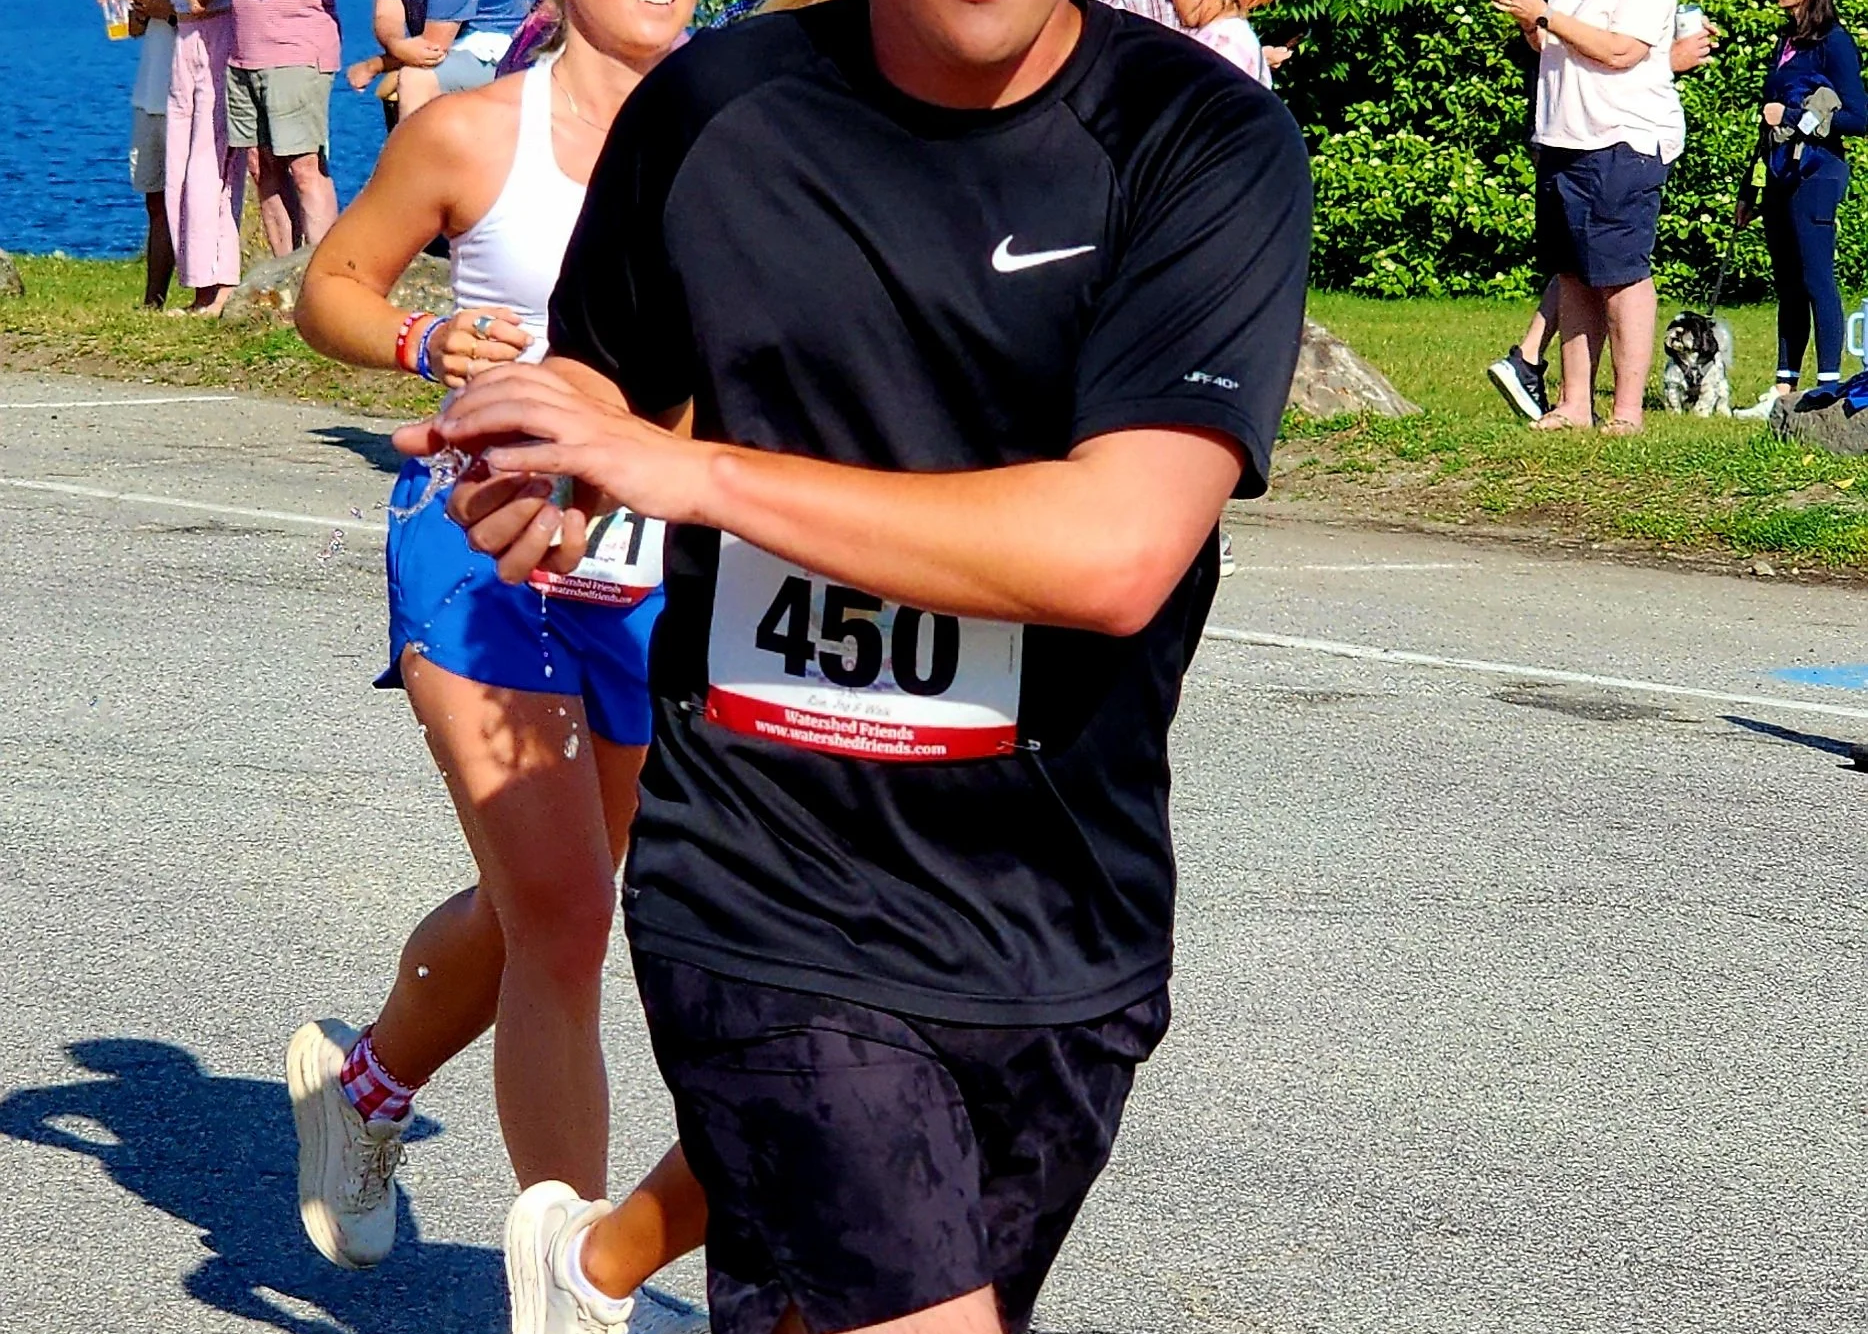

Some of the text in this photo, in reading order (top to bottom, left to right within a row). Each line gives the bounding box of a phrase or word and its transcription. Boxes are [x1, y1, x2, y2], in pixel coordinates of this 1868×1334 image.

[592, 579, 622, 594] Friends
[755, 575, 960, 696] 450
[755, 720, 947, 756] www.watershedfriends.com
[784, 708, 915, 741] Watershed Friends
